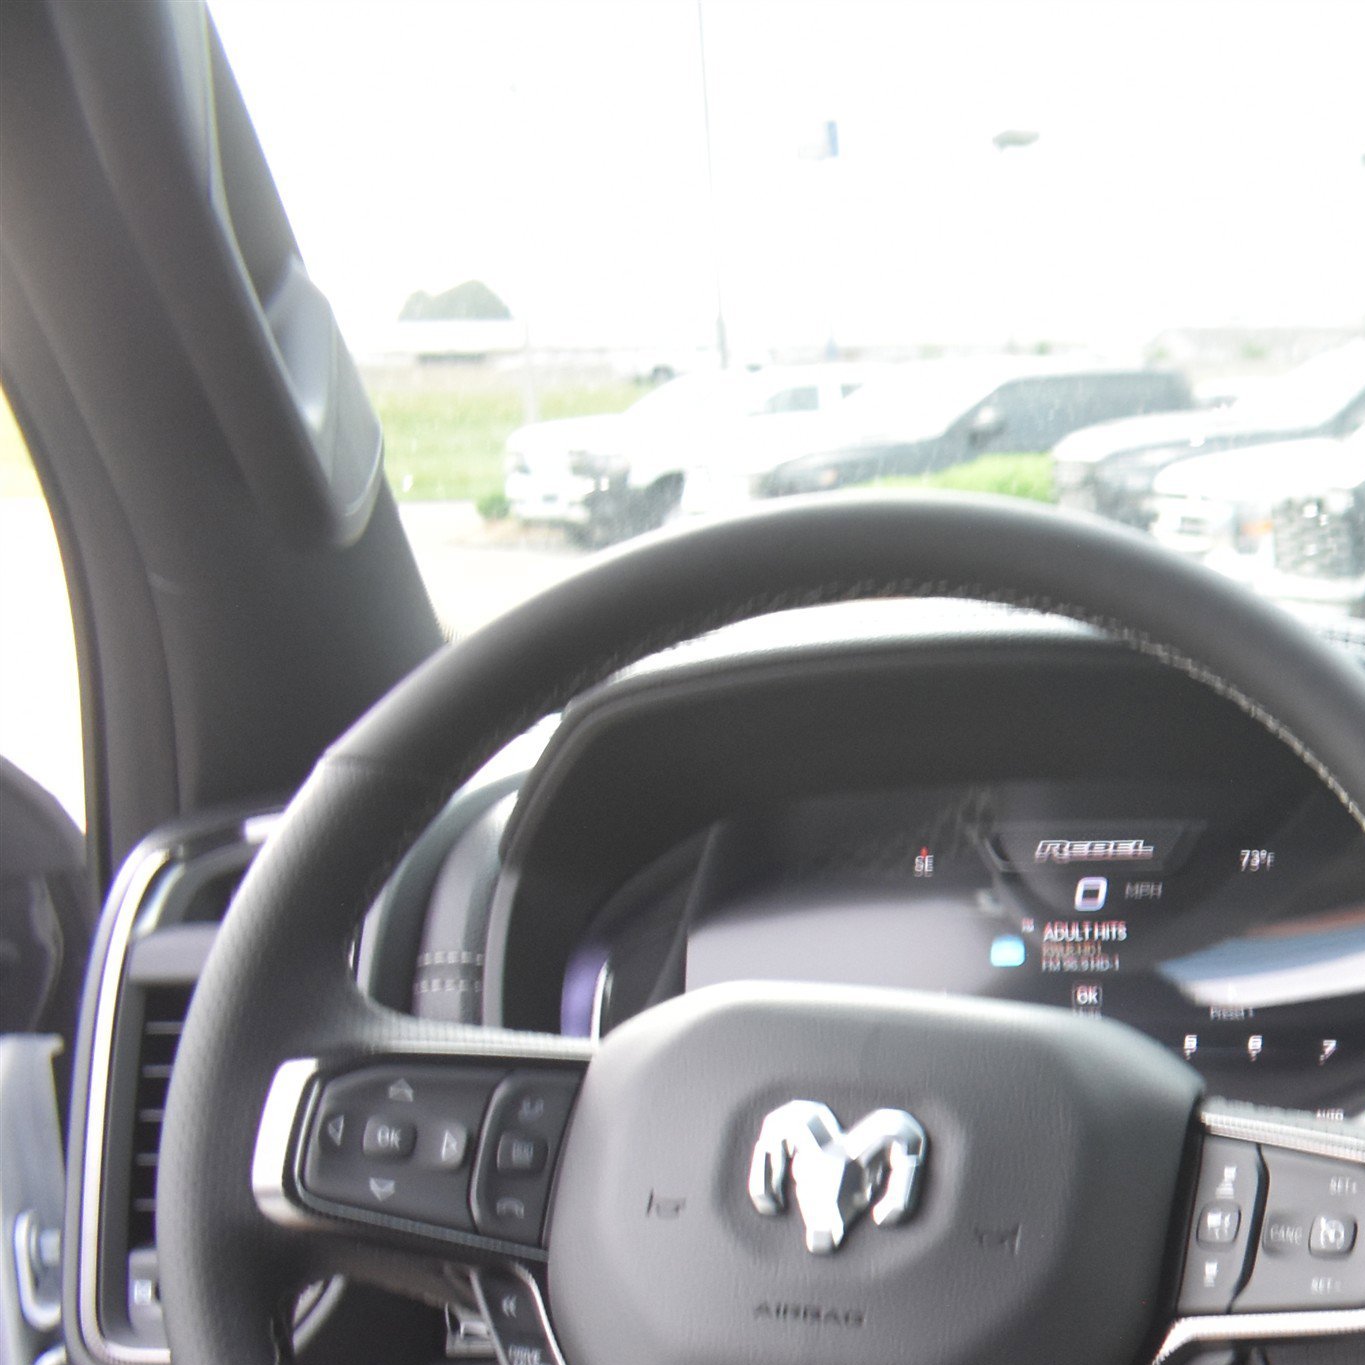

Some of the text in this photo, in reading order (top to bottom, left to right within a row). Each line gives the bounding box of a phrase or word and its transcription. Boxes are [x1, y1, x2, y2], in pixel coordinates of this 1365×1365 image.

[1034, 839, 1155, 862] REBEL
[1043, 920, 1128, 943] ADULT HITS
